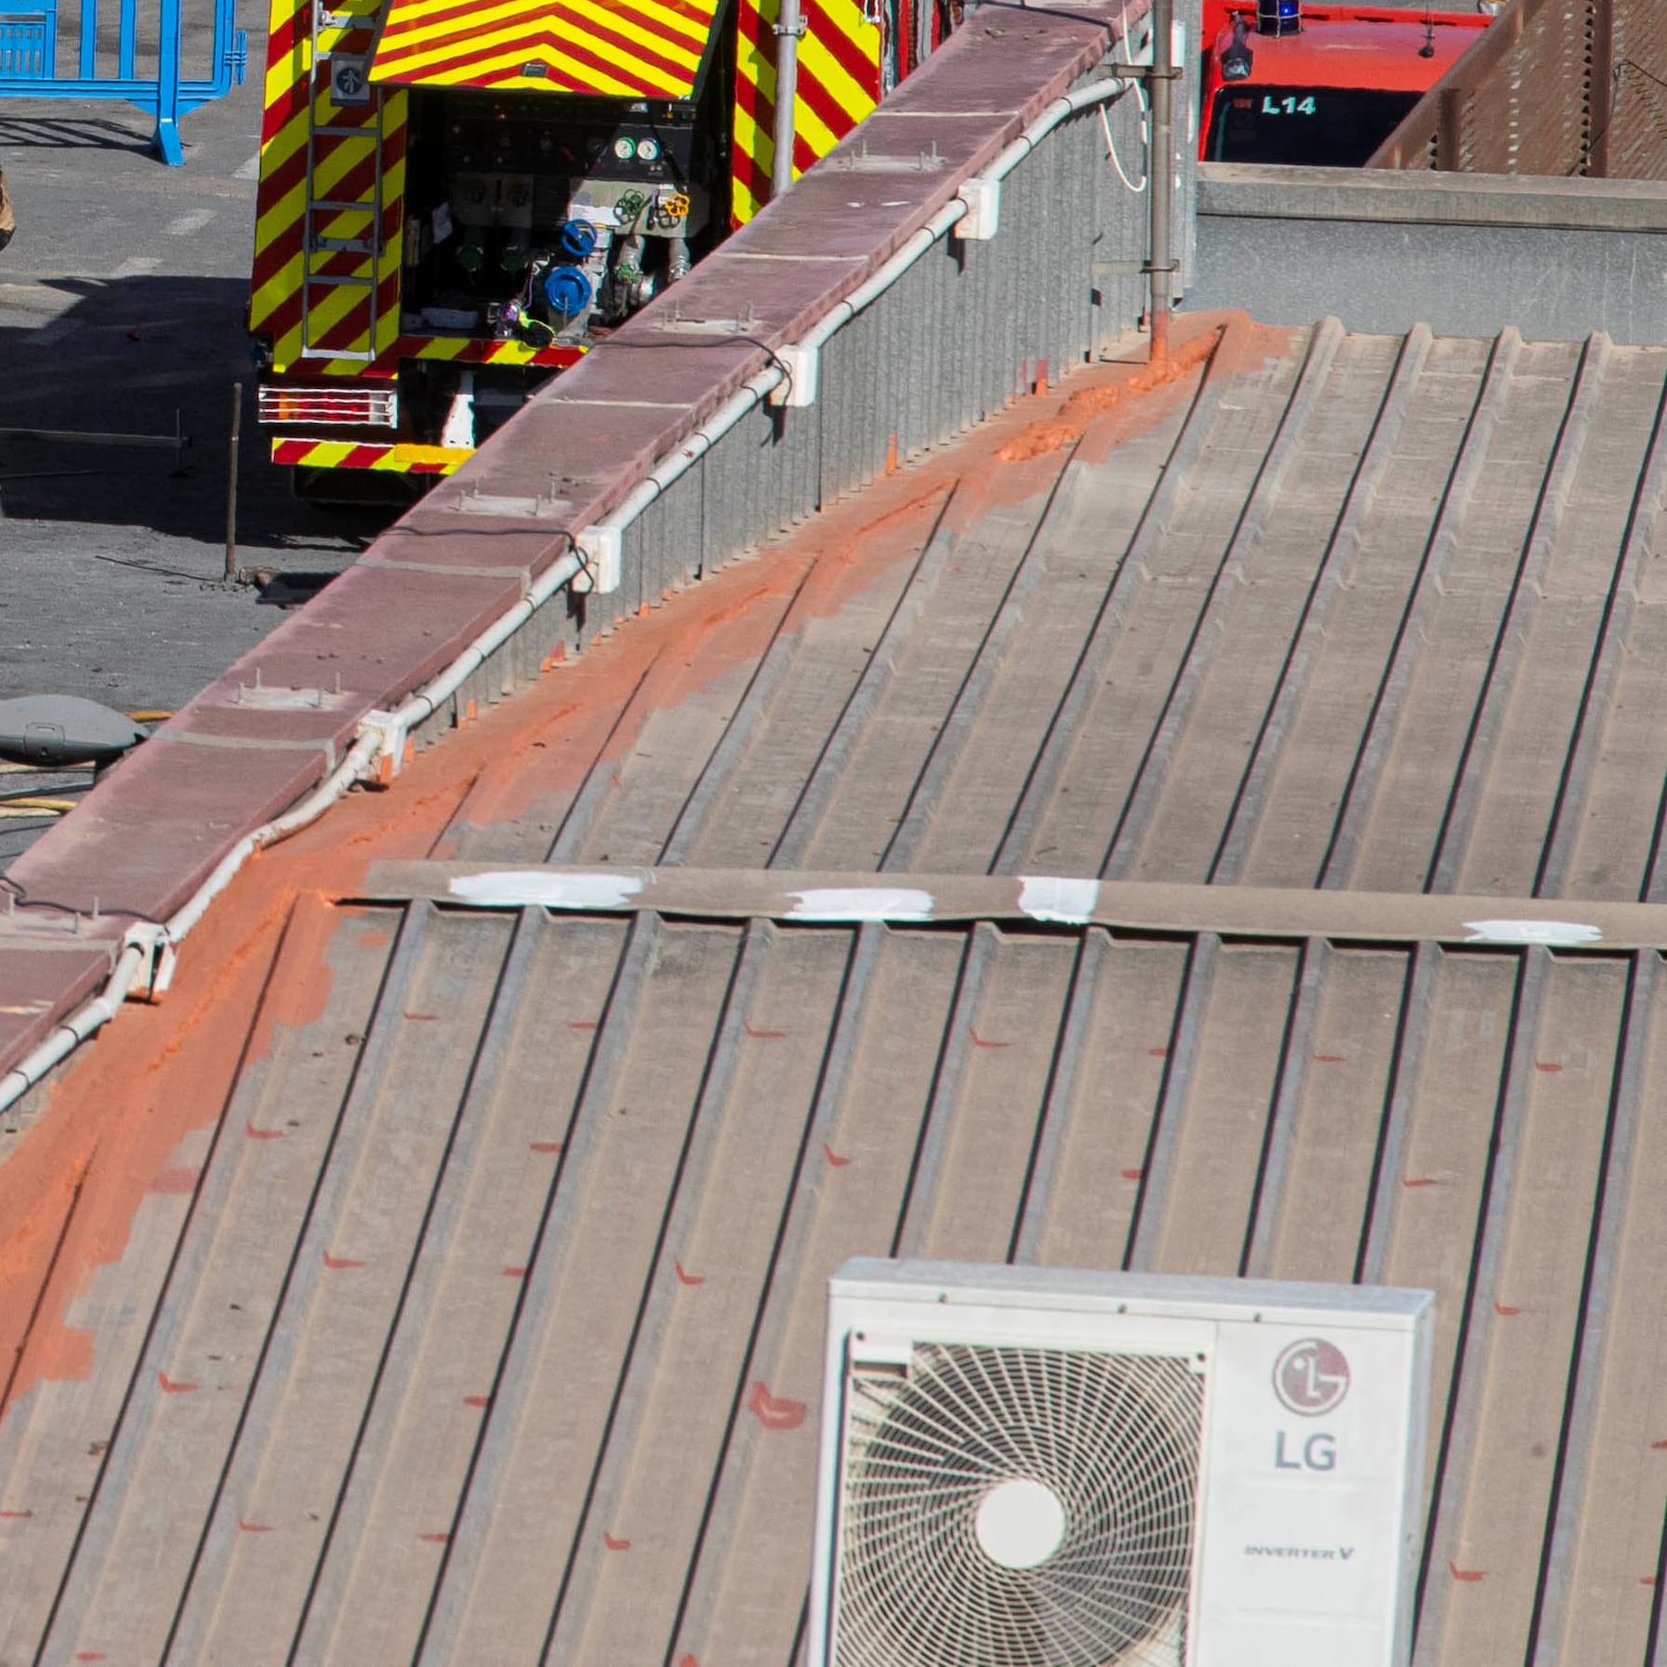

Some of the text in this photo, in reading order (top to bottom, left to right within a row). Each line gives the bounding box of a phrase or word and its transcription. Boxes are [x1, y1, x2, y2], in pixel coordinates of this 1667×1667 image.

[1261, 95, 1316, 115] L14
[1274, 1430, 1338, 1471] LG
[1242, 1544, 1355, 1561] INVERTER V
